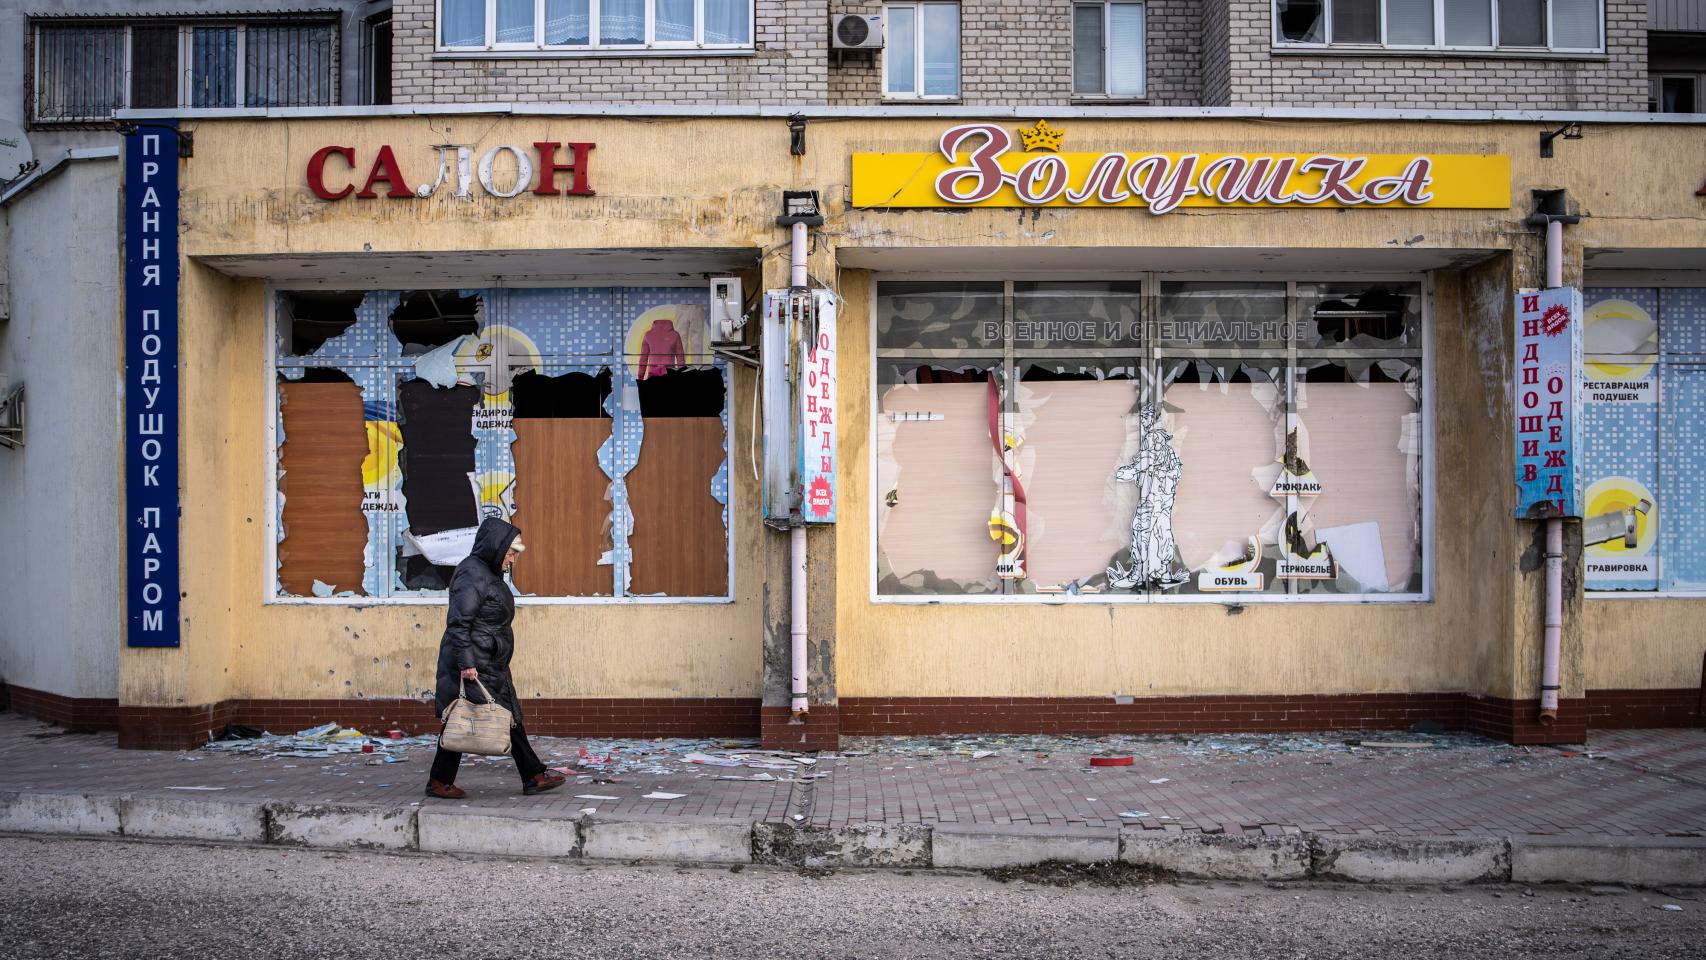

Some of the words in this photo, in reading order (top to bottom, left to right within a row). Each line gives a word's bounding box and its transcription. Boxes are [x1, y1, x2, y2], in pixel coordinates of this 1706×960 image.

[306, 141, 597, 202] САЛОН
[140, 134, 161, 287] ПРАННЯ
[983, 321, 1097, 341] ВОЕННОЕ
[1104, 321, 1121, 341] И
[1129, 321, 1307, 344] СПЕЦИАЛЬНОЕ
[139, 309, 163, 488] ПОДУШОК
[819, 332, 833, 474] ОДЕЖДЫ
[1584, 382, 1649, 391] РЕСТАВРАЦИЯ
[1593, 393, 1639, 401] ПОДУШЕК
[142, 507, 163, 632] ПАРОМ
[1214, 577, 1248, 587] ОБУВЬ
[1587, 564, 1648, 572] ГРАВИРОВКА
